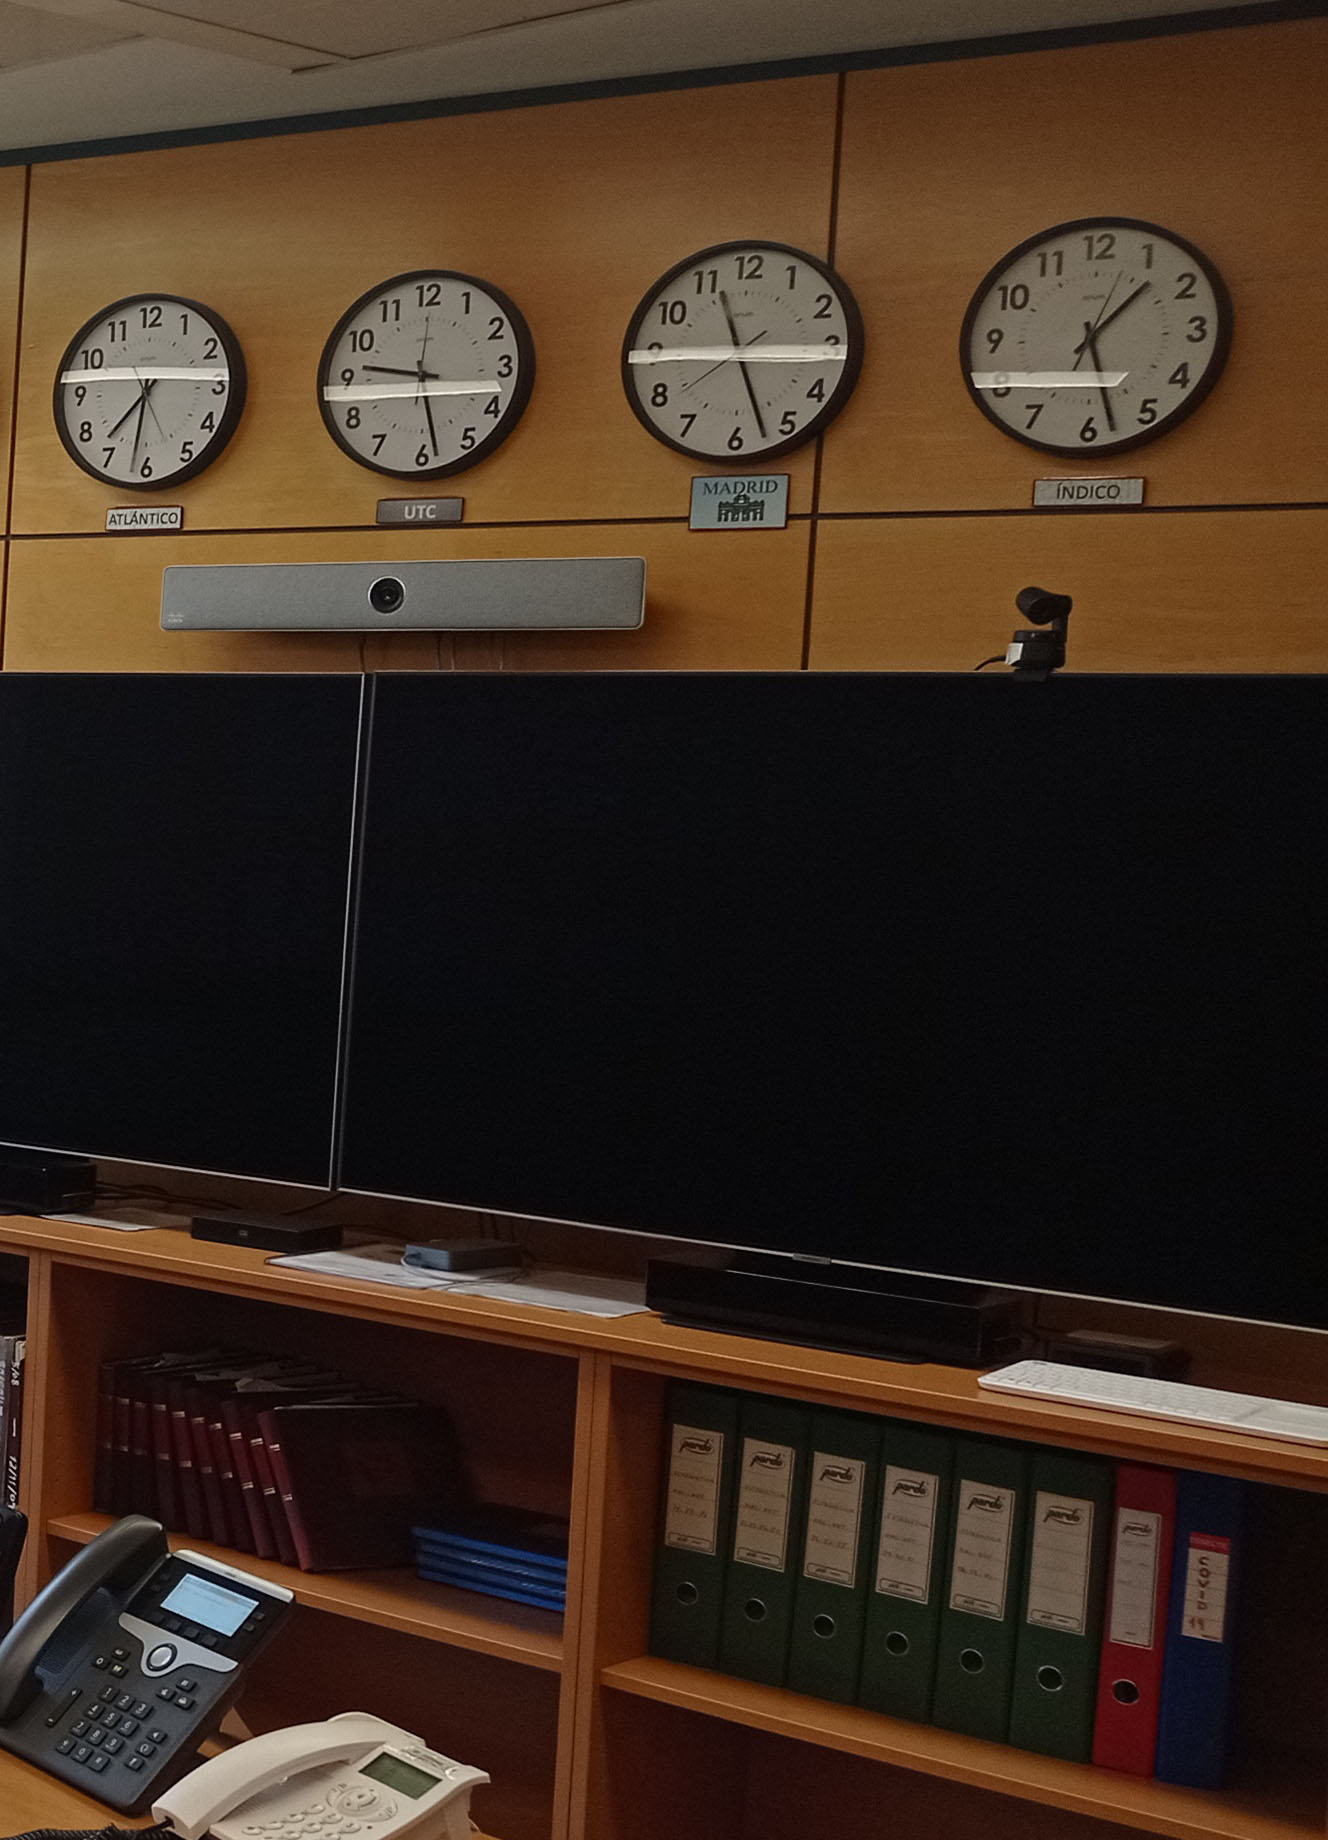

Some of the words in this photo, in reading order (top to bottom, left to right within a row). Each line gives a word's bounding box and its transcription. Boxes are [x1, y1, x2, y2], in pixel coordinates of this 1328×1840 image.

[1083, 233, 1116, 261] 12
[1142, 244, 1154, 269] 1
[734, 255, 764, 280] 12
[1036, 251, 1064, 277] 11
[693, 270, 718, 294] 11
[785, 266, 797, 290] 1
[1174, 272, 1197, 300] 2
[416, 284, 441, 307] 12
[461, 292, 471, 314] 1
[813, 294, 832, 319] 2
[997, 284, 1029, 310] 10
[140, 306, 162, 328] 12
[379, 299, 400, 322] 11
[658, 300, 686, 325] 10
[108, 320, 126, 342] 11
[180, 314, 188, 335] 1
[487, 317, 504, 340] 2
[1186, 316, 1206, 342] 3
[203, 338, 218, 360] 2
[348, 329, 374, 352] 10
[986, 328, 1004, 353] 9
[81, 348, 103, 370] 10
[497, 355, 512, 377] 3
[212, 374, 225, 395] 3
[341, 369, 354, 390] 9
[1168, 362, 1190, 389] 4
[75, 386, 86, 406] 9
[651, 383, 668, 407] 8
[806, 378, 825, 402] 4
[346, 407, 360, 429] 8
[484, 396, 500, 418] 4
[1025, 404, 1043, 429] 7
[1137, 399, 1158, 424] 5
[79, 422, 92, 442] 8
[200, 412, 214, 432] 4
[680, 414, 697, 438] 7
[778, 411, 796, 435] 5
[1080, 417, 1097, 442] 6
[372, 434, 387, 456] 7
[460, 427, 476, 450] 5
[728, 427, 743, 451] 6
[102, 447, 116, 468] 7
[180, 441, 193, 462] 5
[416, 444, 429, 467] 6
[140, 457, 152, 477] 6
[703, 479, 778, 495] MADRID
[1056, 483, 1120, 500] ÍNDICO
[109, 511, 178, 525] ATLÁNTICO
[404, 505, 436, 519] UTC
[750, 1452, 785, 1467] pardo
[820, 1466, 855, 1481] pardo
[892, 1480, 927, 1496] pardo
[967, 1495, 1003, 1510] pardo
[1043, 1508, 1082, 1523] pardo
